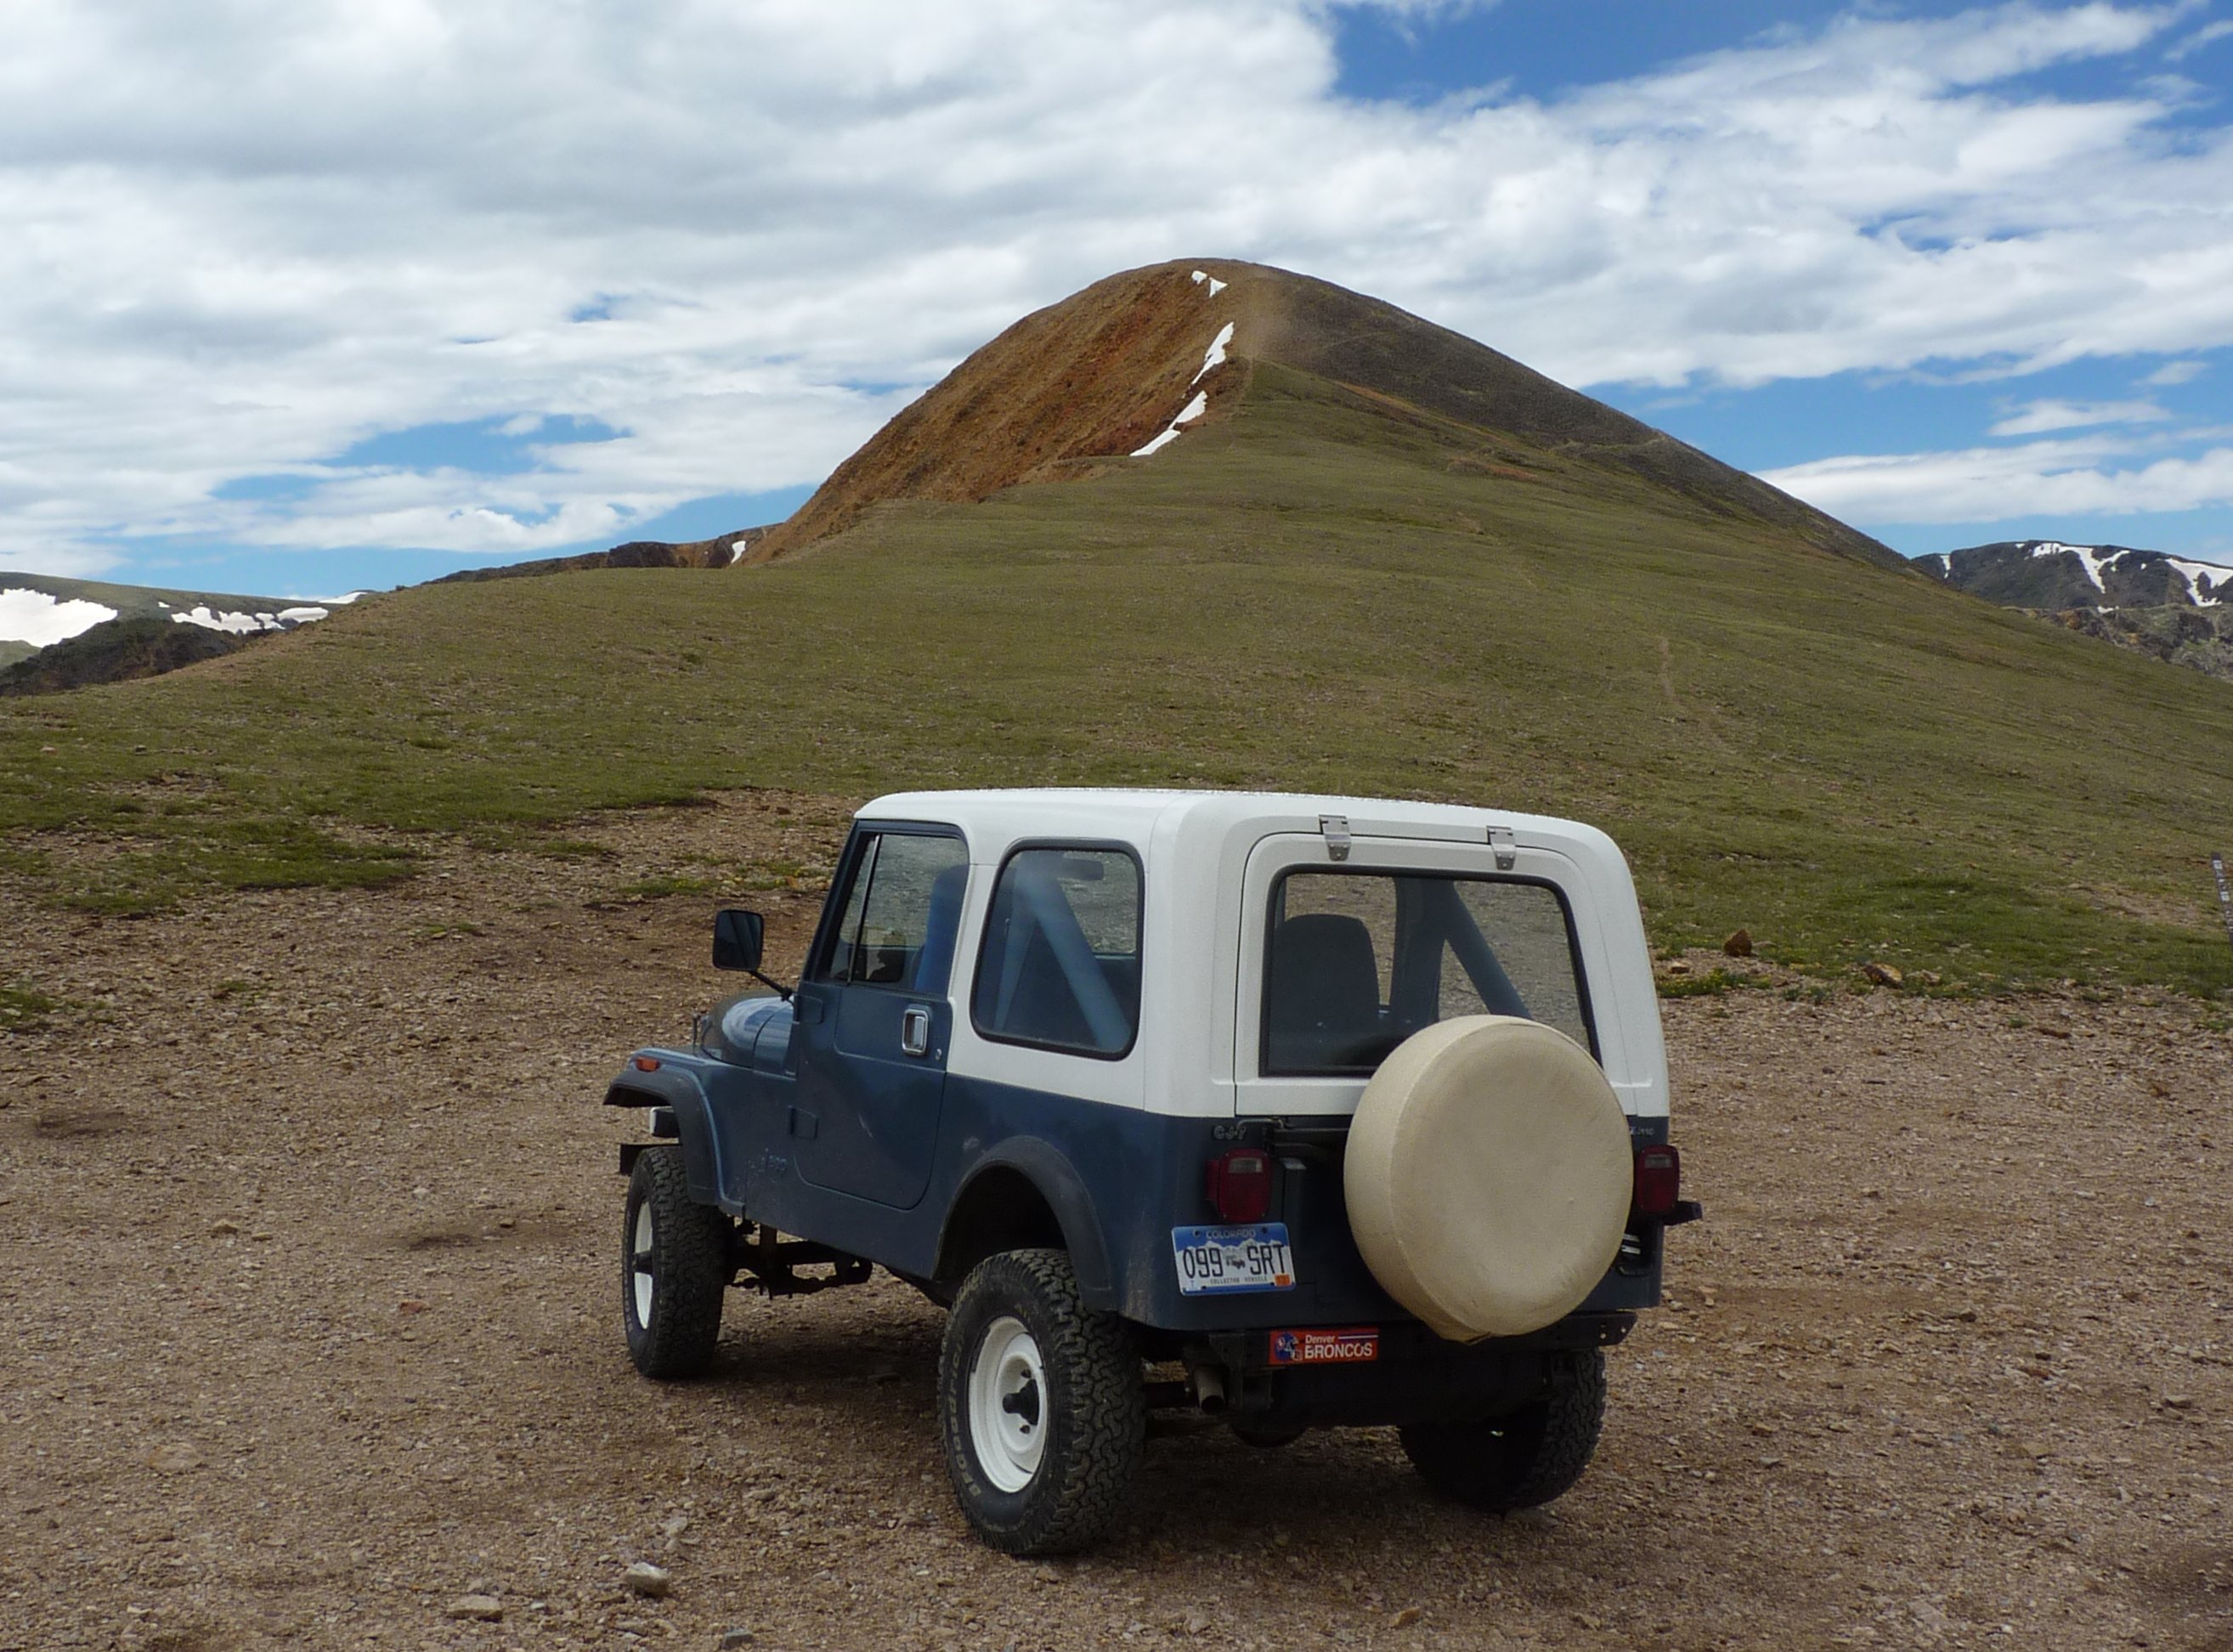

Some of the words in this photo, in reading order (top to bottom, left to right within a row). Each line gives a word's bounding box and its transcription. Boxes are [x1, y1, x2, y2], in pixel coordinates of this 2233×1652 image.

[1206, 1229, 1257, 1239] COLORADO
[1183, 1247, 1224, 1278] 099
[1247, 1244, 1285, 1275] SRT
[1305, 1334, 1335, 1344] Denver
[1304, 1343, 1373, 1359] BRONCOS
